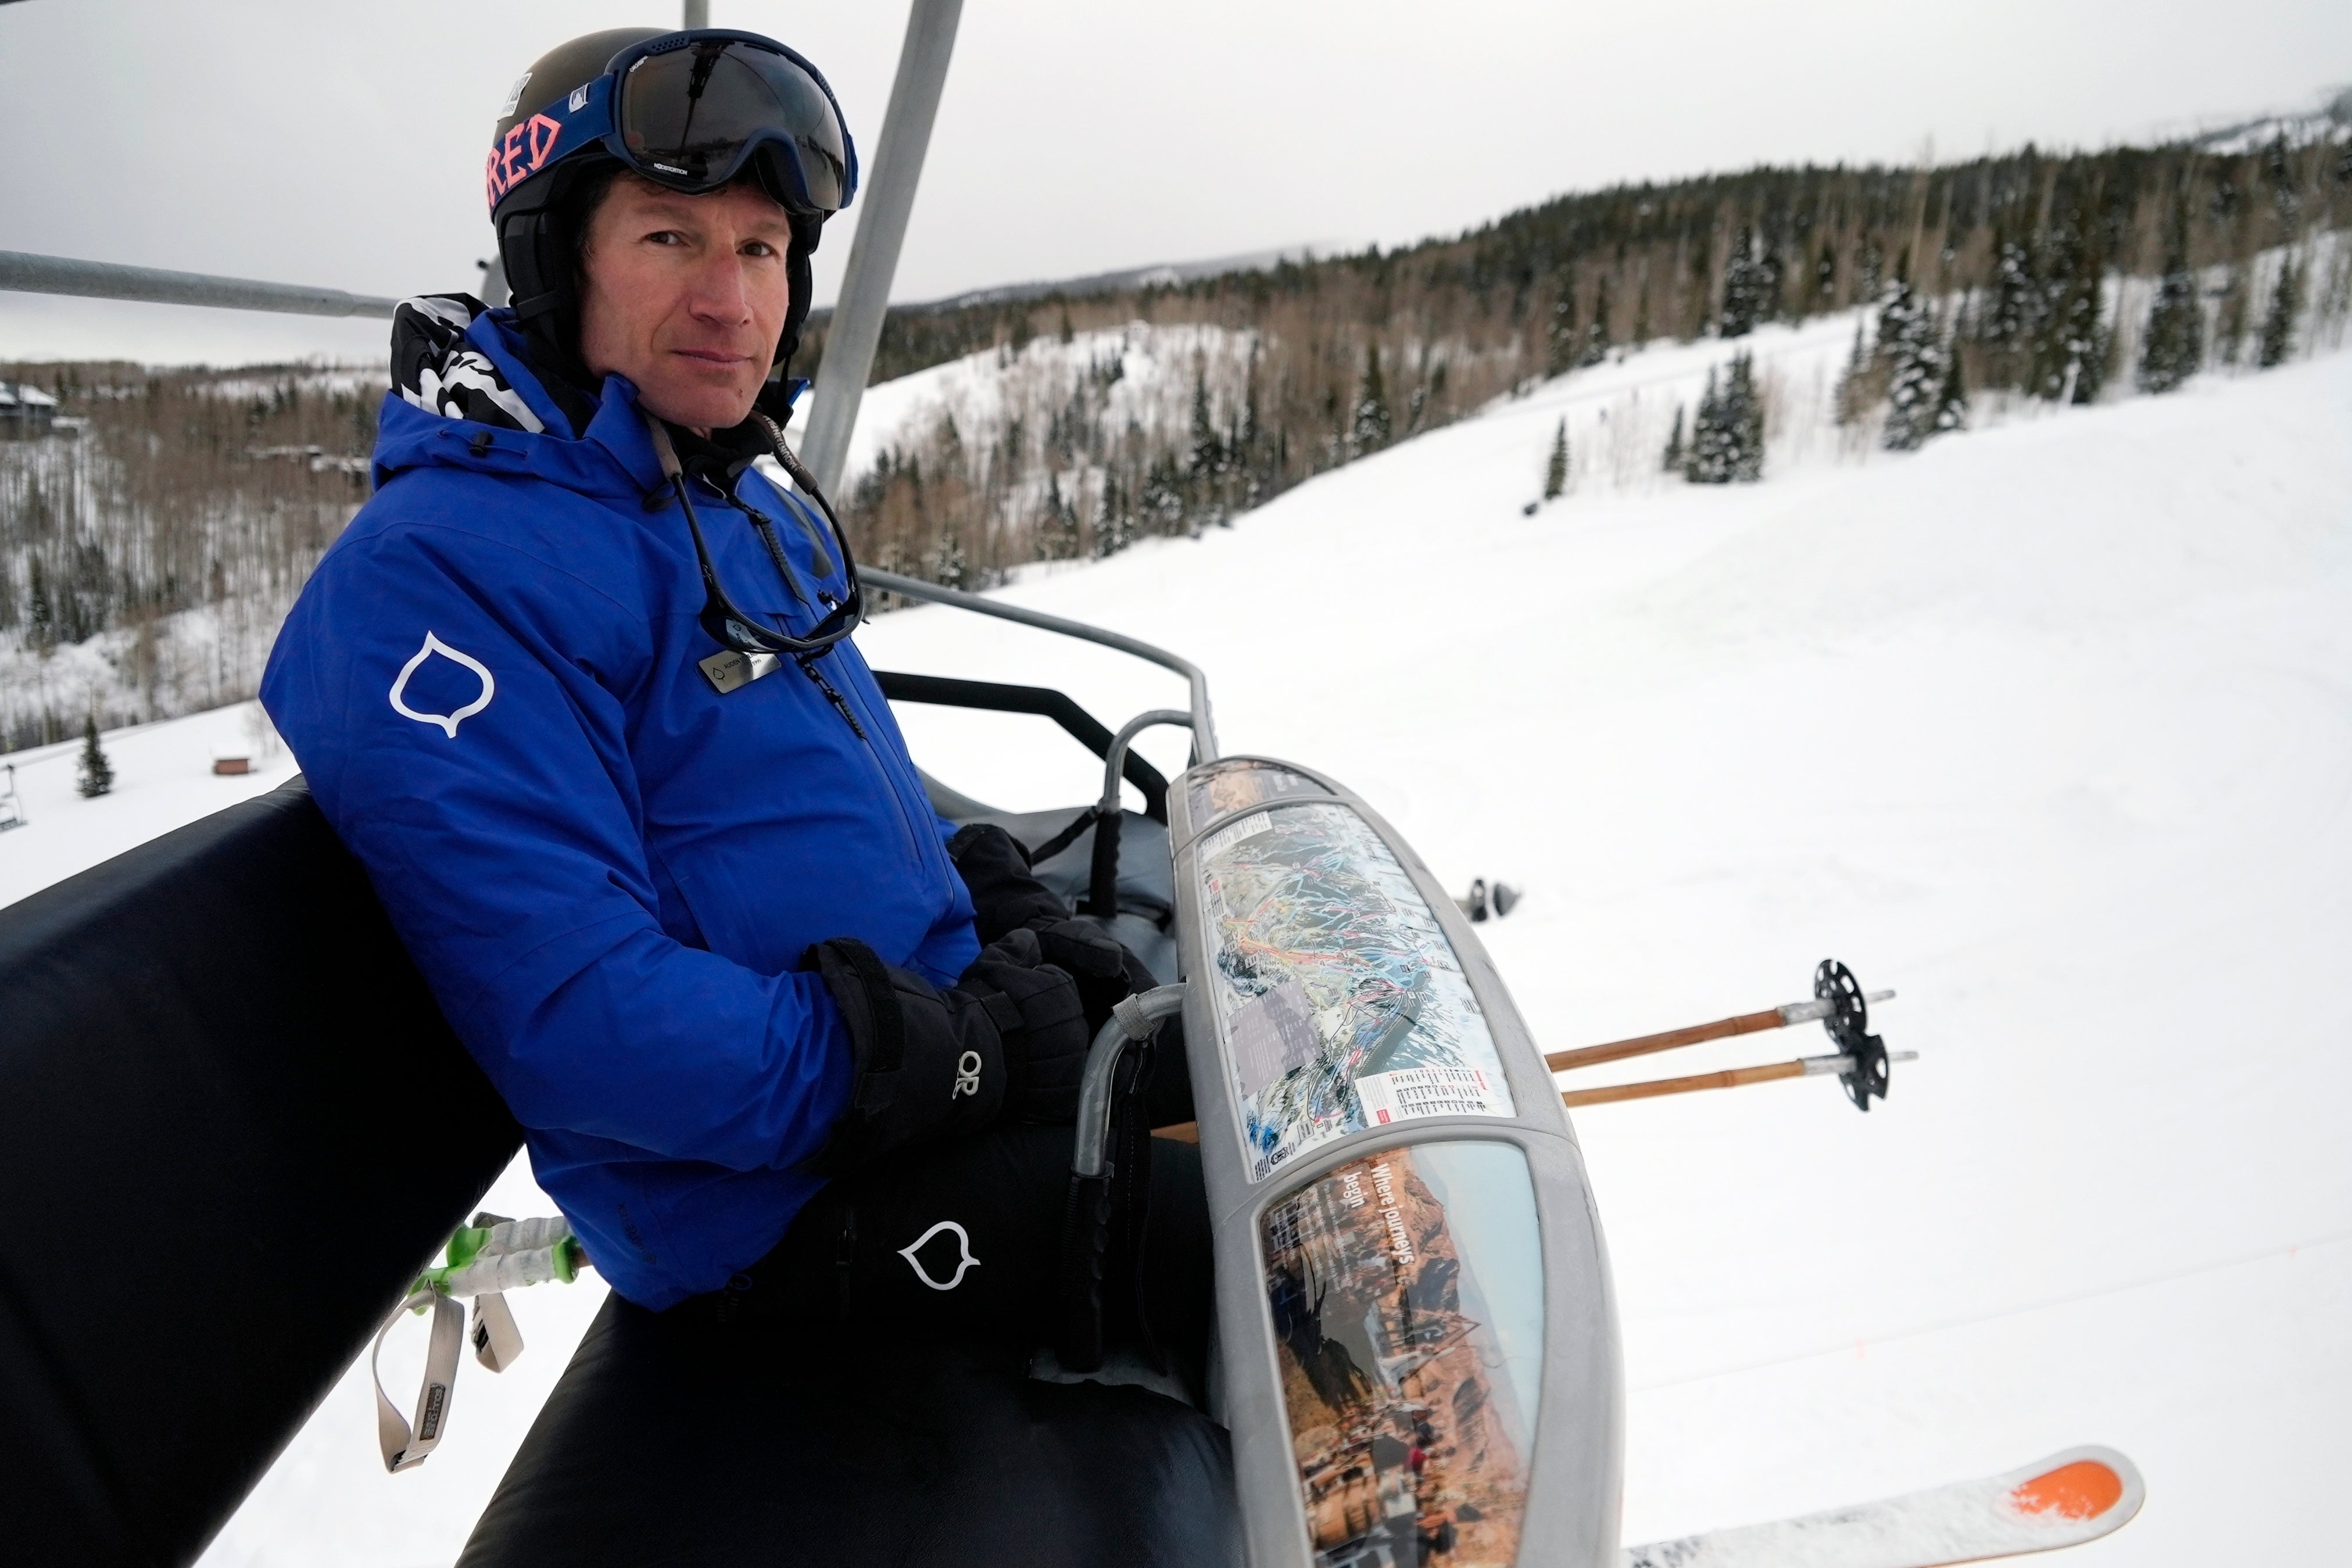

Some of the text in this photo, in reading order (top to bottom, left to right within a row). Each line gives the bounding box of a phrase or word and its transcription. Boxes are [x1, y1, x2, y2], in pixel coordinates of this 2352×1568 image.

[485, 113, 561, 209] RED
[1343, 1171, 1368, 1208] begin
[1371, 1163, 1415, 1265] Where journeys
